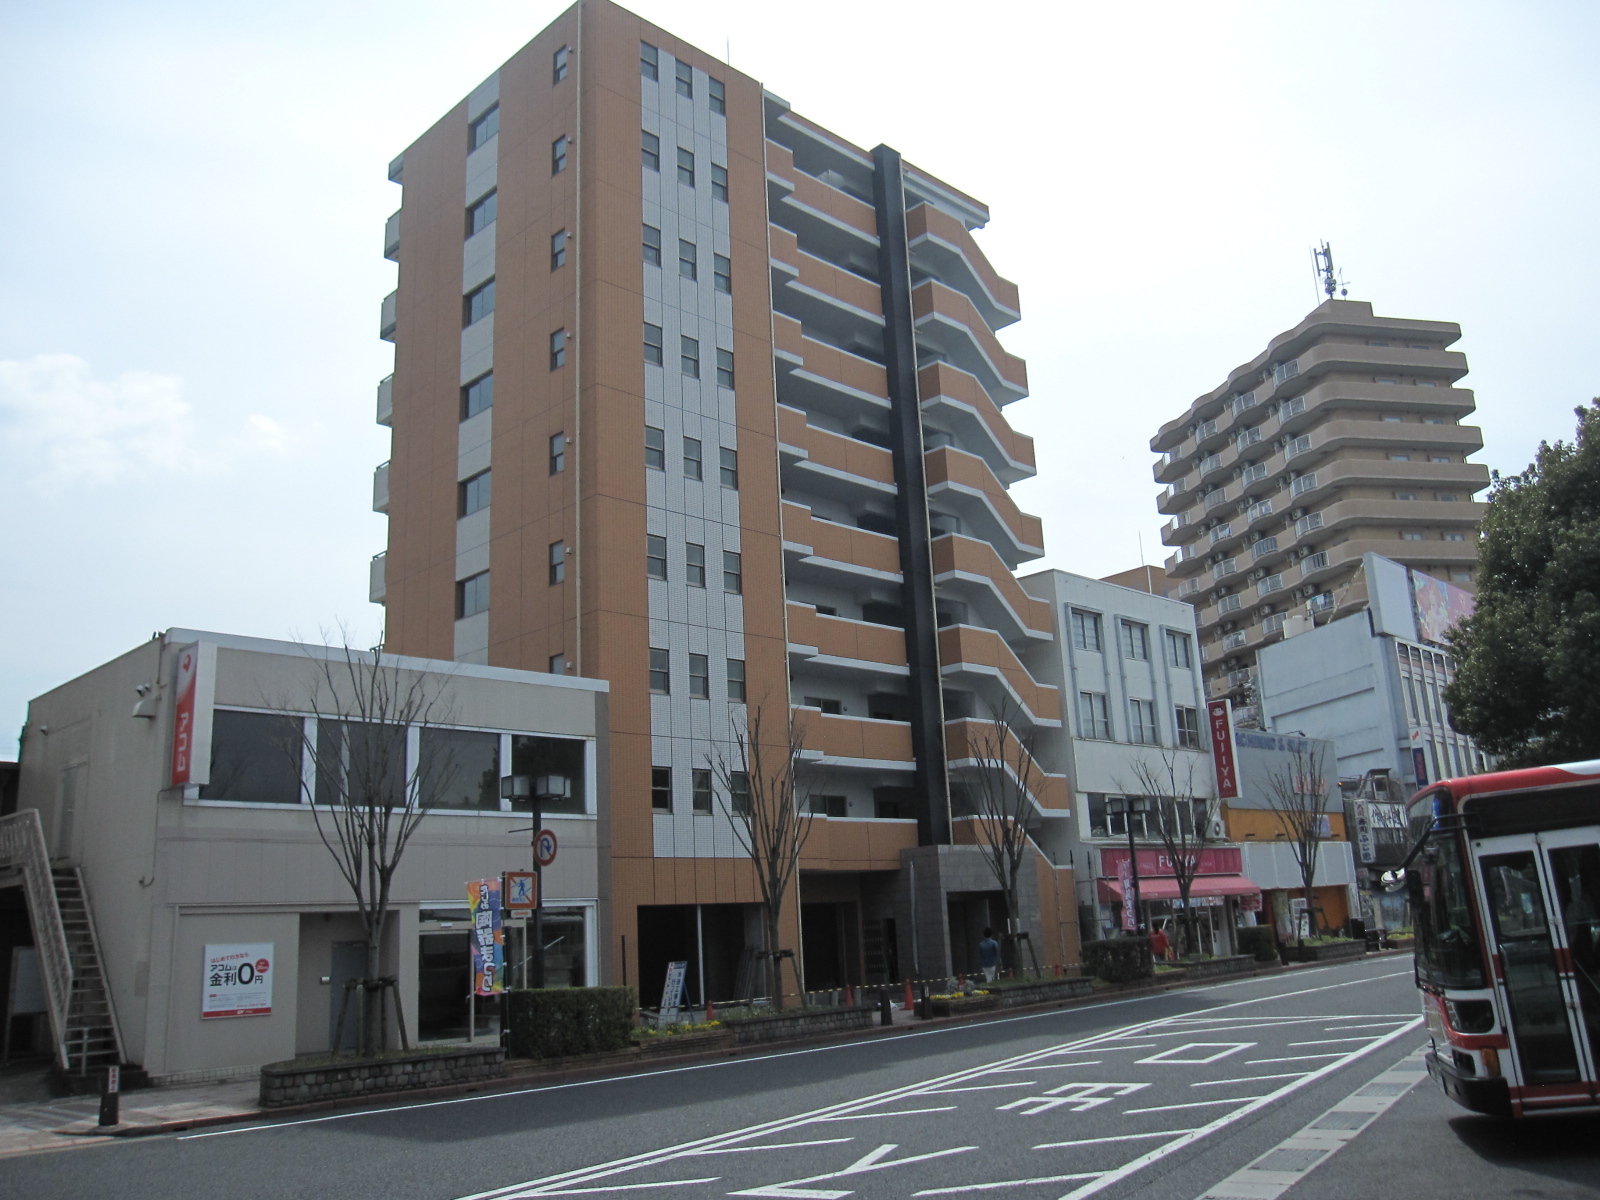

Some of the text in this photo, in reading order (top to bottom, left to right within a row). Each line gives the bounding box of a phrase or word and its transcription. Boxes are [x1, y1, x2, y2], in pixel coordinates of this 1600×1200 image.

[177, 711, 189, 772] アコム
[1215, 719, 1232, 788] FUJIYA
[1158, 855, 1196, 867] FUYA
